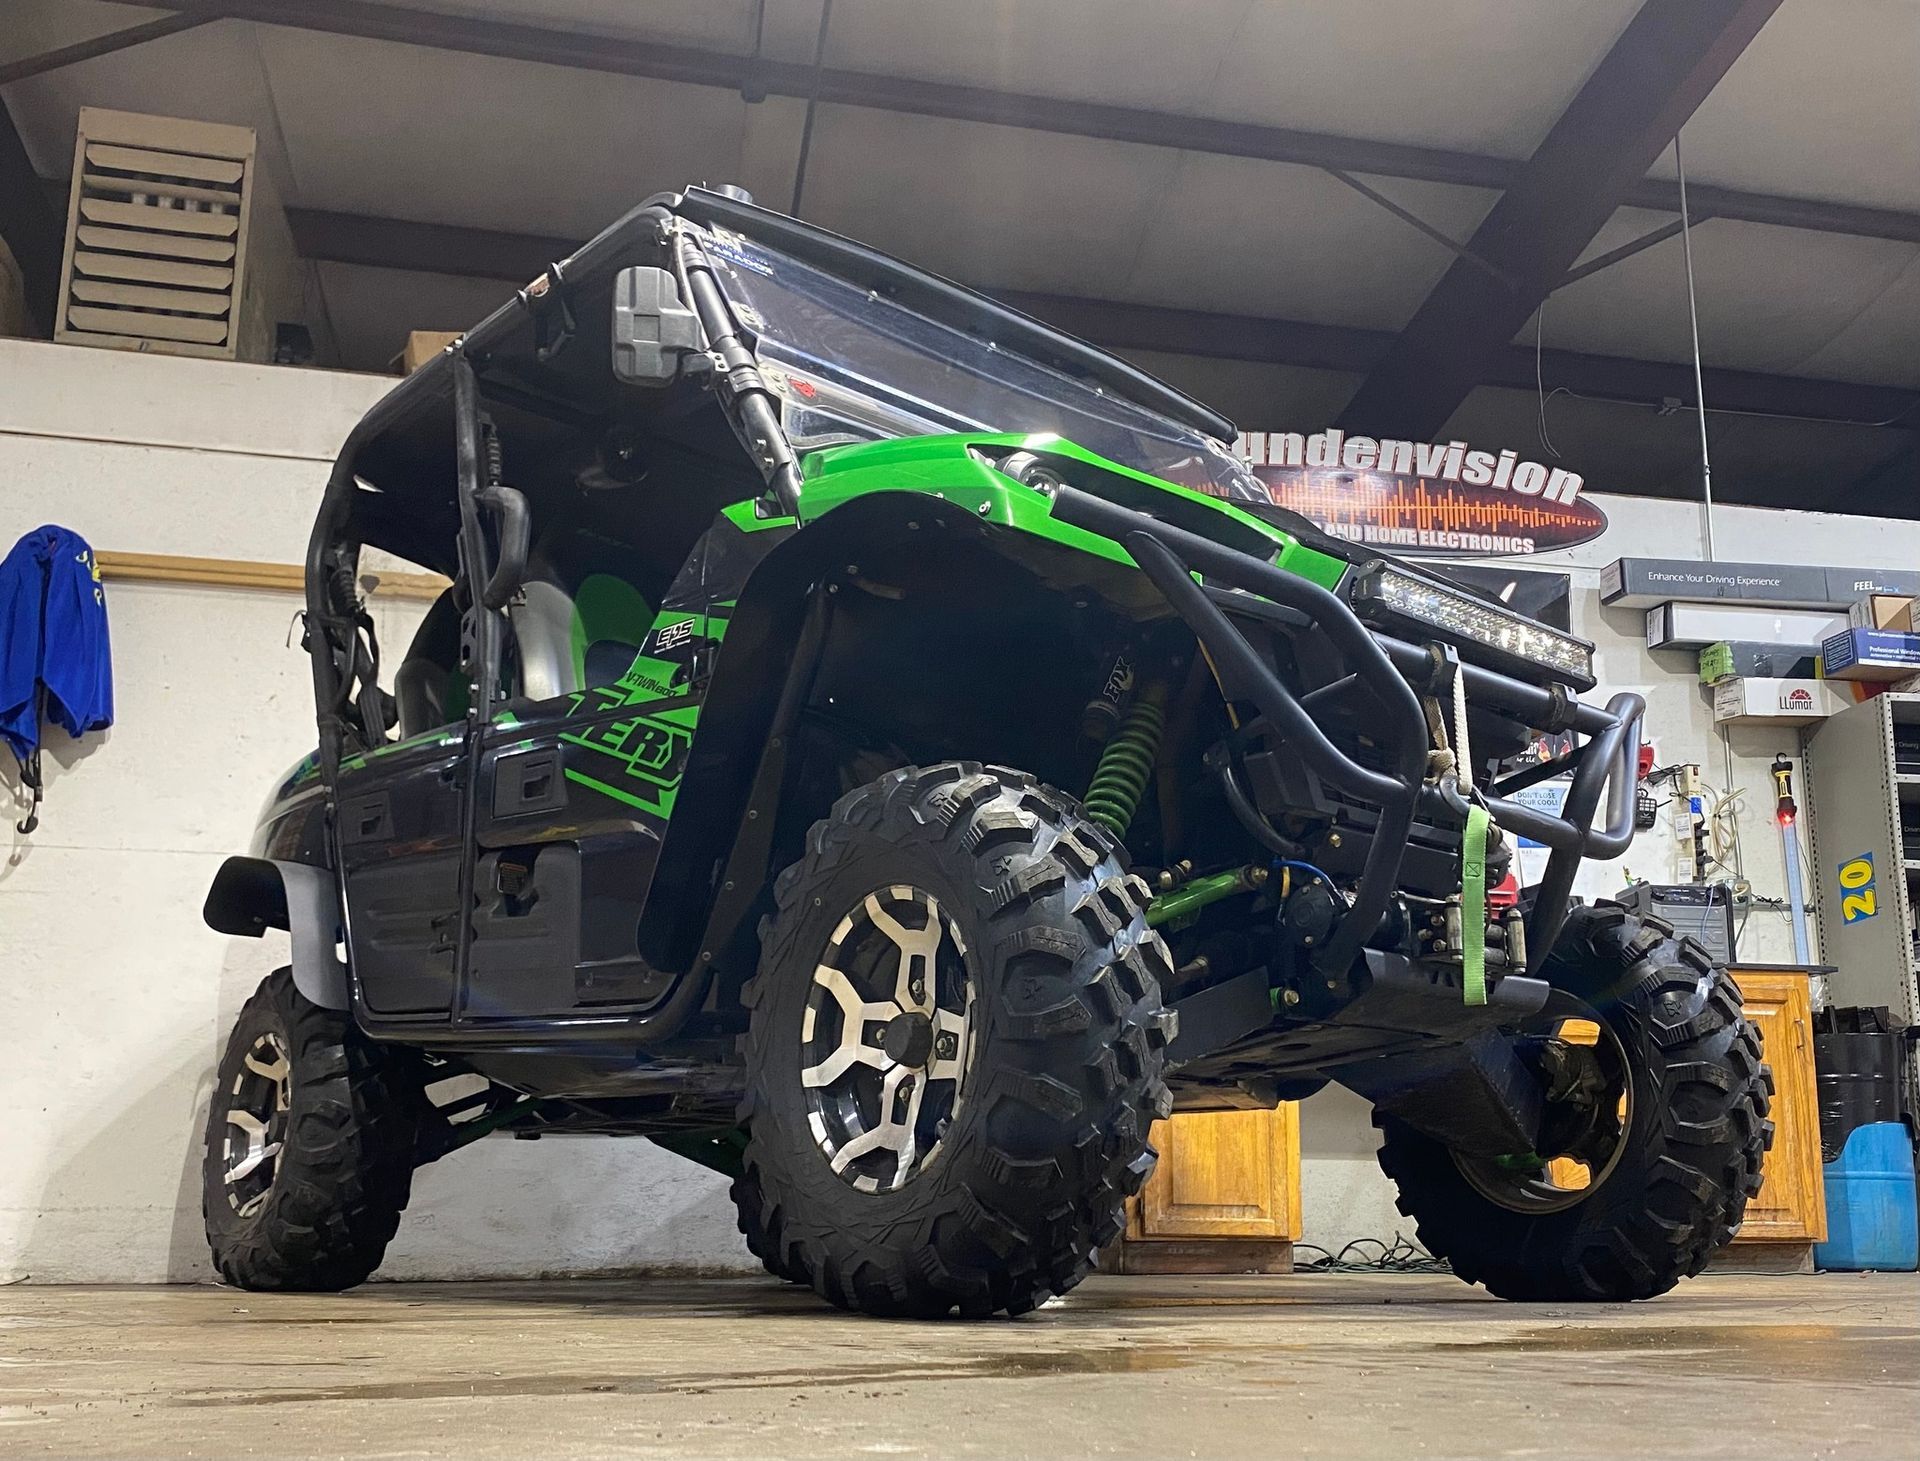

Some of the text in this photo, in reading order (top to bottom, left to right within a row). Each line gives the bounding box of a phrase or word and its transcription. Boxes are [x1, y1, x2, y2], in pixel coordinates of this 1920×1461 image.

[1364, 524, 1418, 546] HOME
[1418, 529, 1535, 553] ELECTRONICS
[1648, 571, 1781, 586] Enhance Your Driving Experience
[1854, 580, 1875, 592] FEEL
[656, 618, 696, 647] EPS
[1838, 857, 1877, 922] 20
